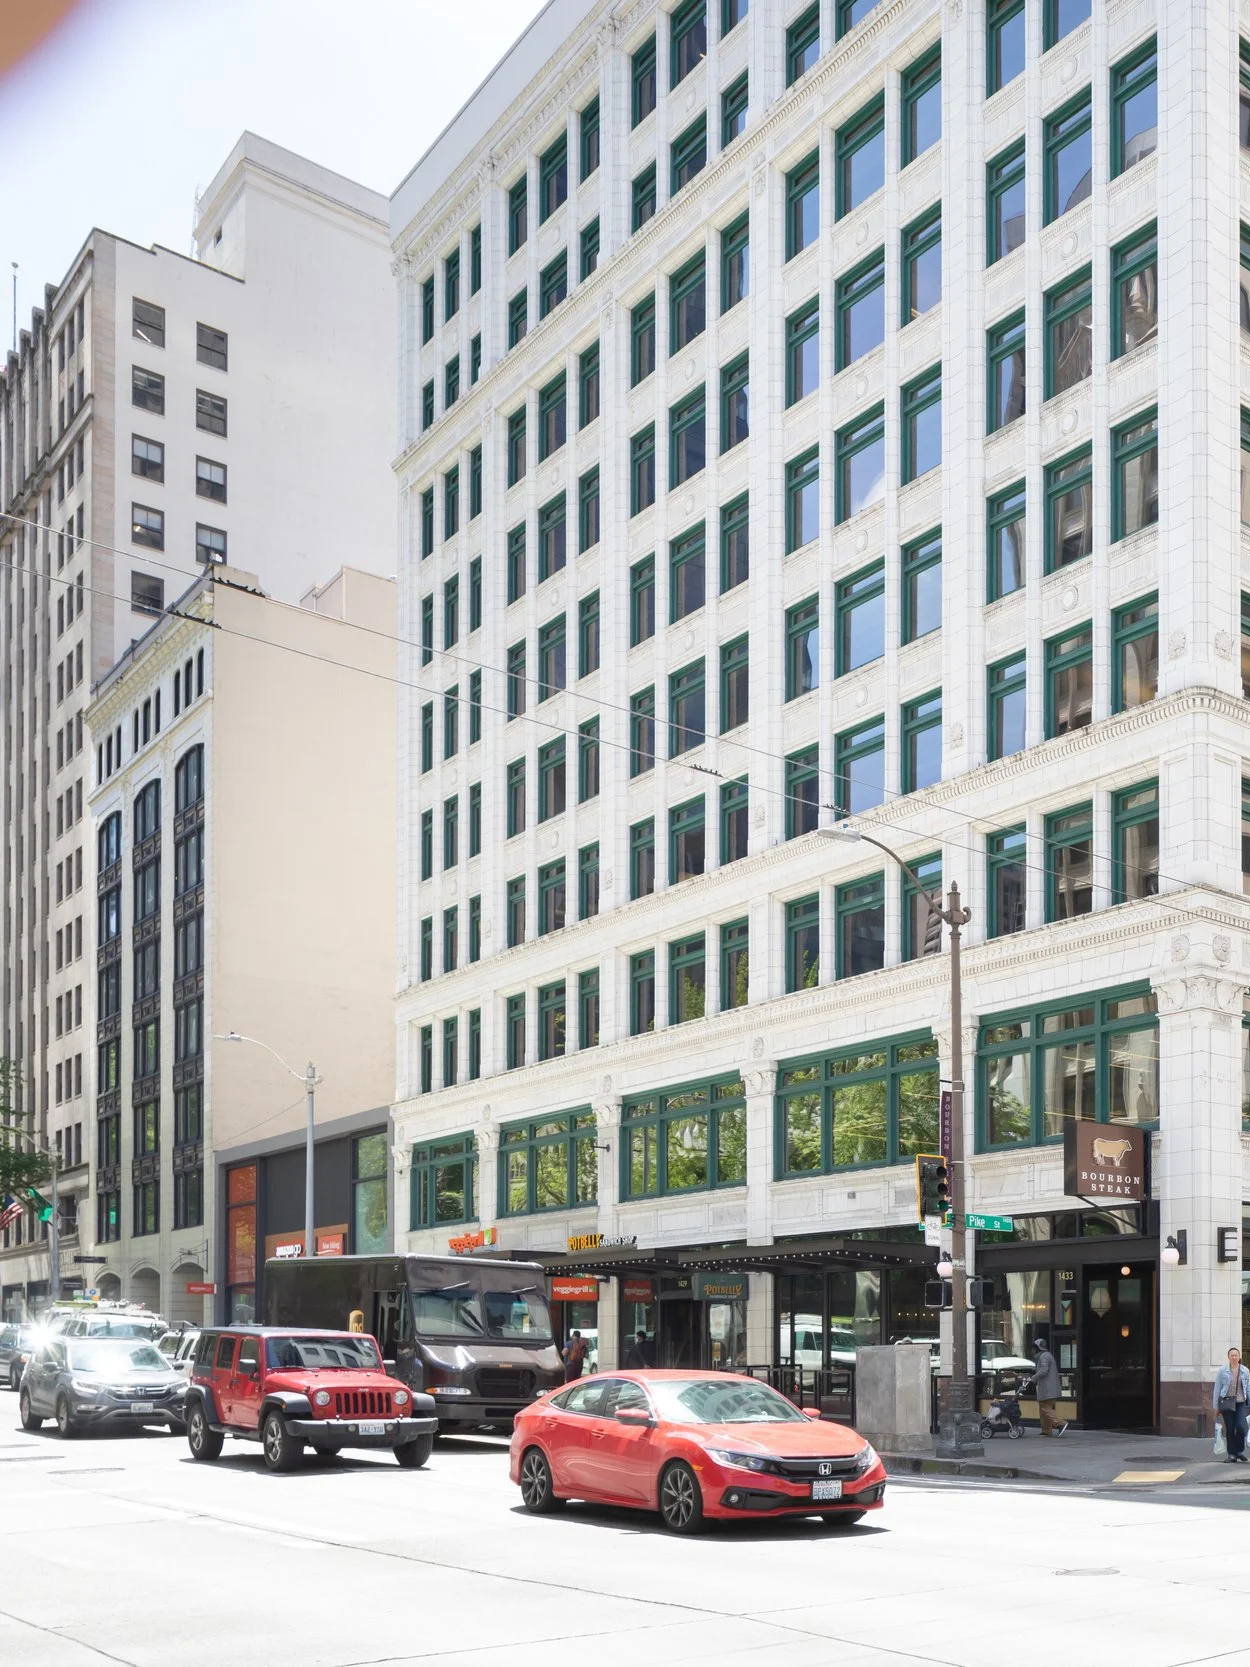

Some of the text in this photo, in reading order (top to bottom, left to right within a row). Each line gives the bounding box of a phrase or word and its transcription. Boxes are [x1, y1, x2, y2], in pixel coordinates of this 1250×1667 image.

[1081, 1171, 1140, 1185] BOURBON
[1091, 1183, 1131, 1194] STEAK
[969, 1215, 985, 1228] Pike
[993, 1220, 1001, 1229] St
[568, 1234, 601, 1251] POTBELLY
[1058, 1271, 1074, 1280] 1433
[553, 1285, 589, 1295] veggiegrill
[703, 1283, 743, 1297] POTBELLY
